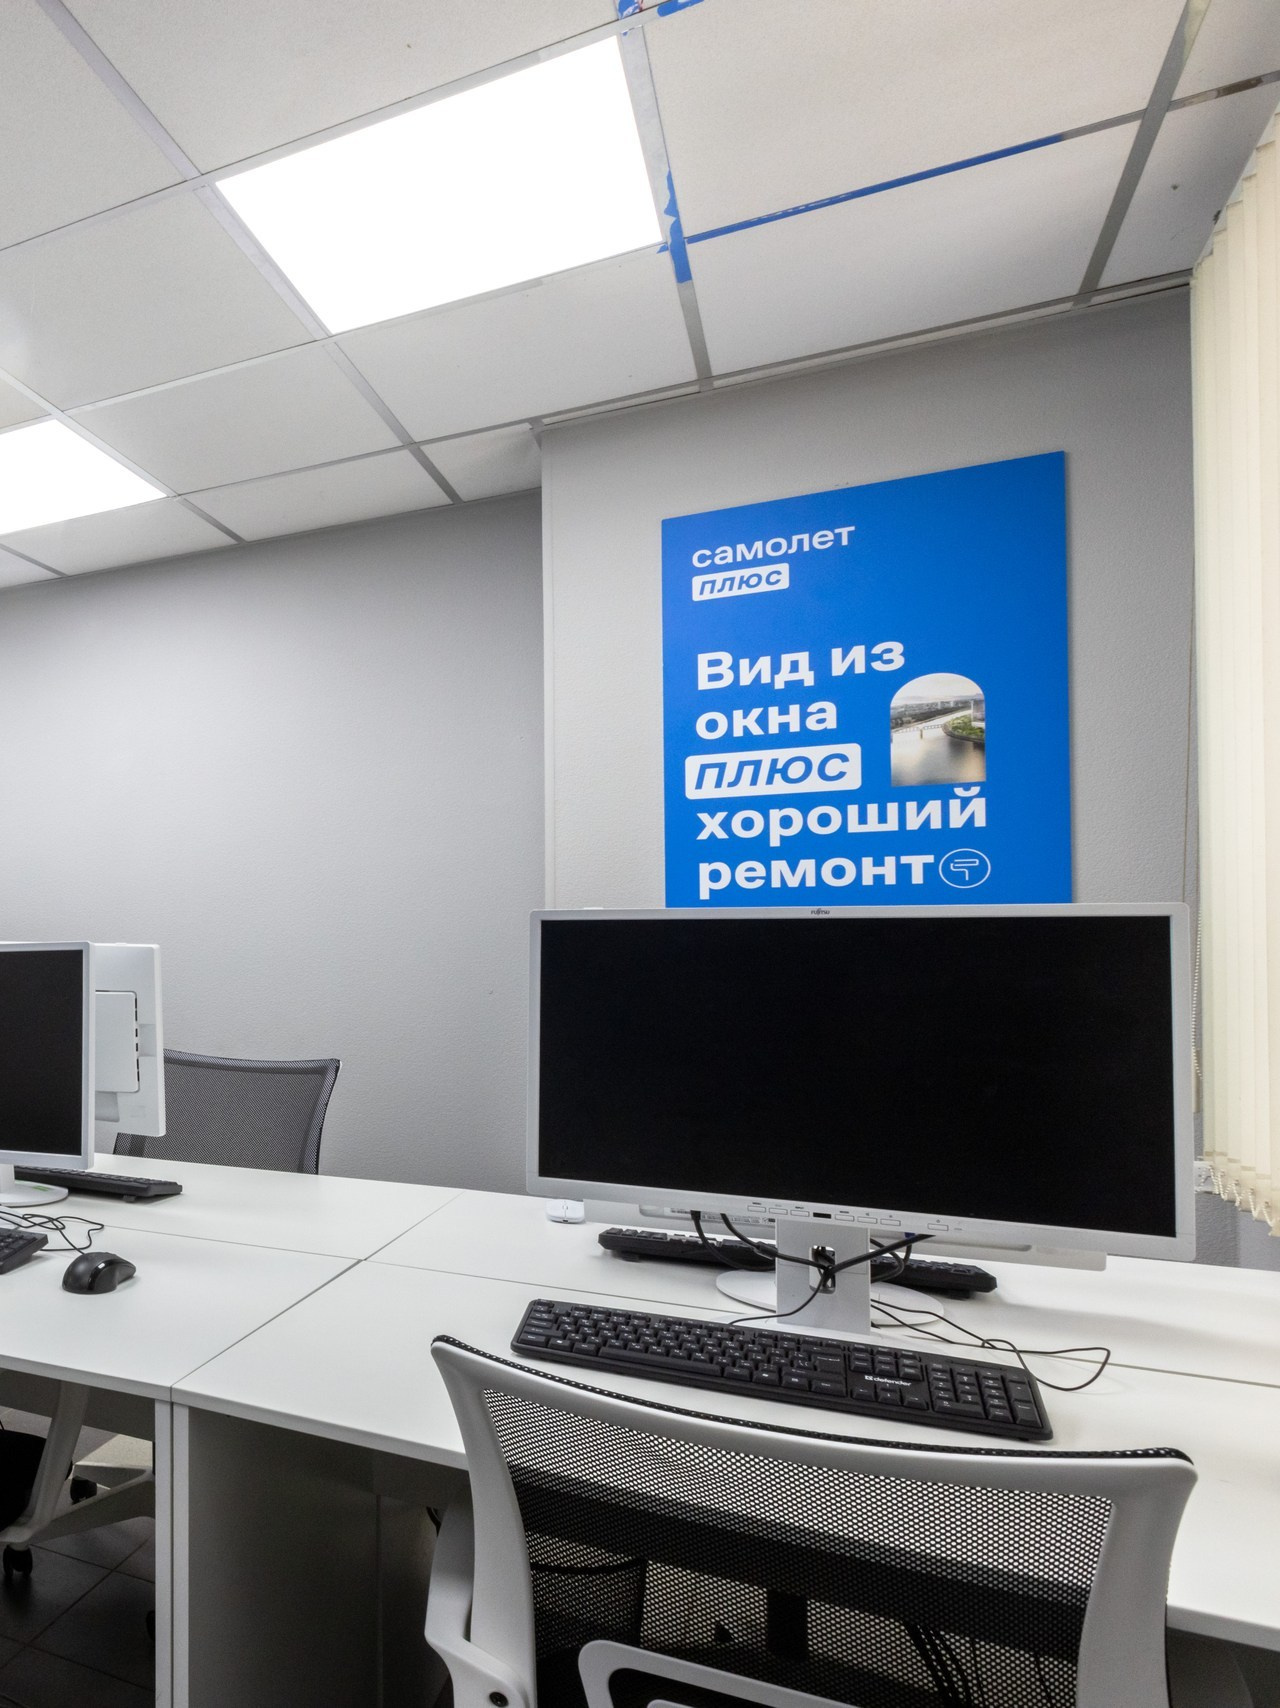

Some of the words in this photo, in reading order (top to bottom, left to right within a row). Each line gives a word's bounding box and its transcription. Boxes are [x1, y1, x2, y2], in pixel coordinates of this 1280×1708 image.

[691, 526, 855, 568] самолет
[697, 651, 815, 691] Вид
[831, 641, 905, 677] из
[695, 701, 837, 740] окна
[696, 786, 987, 848] хороший
[699, 854, 935, 900] ремонт
